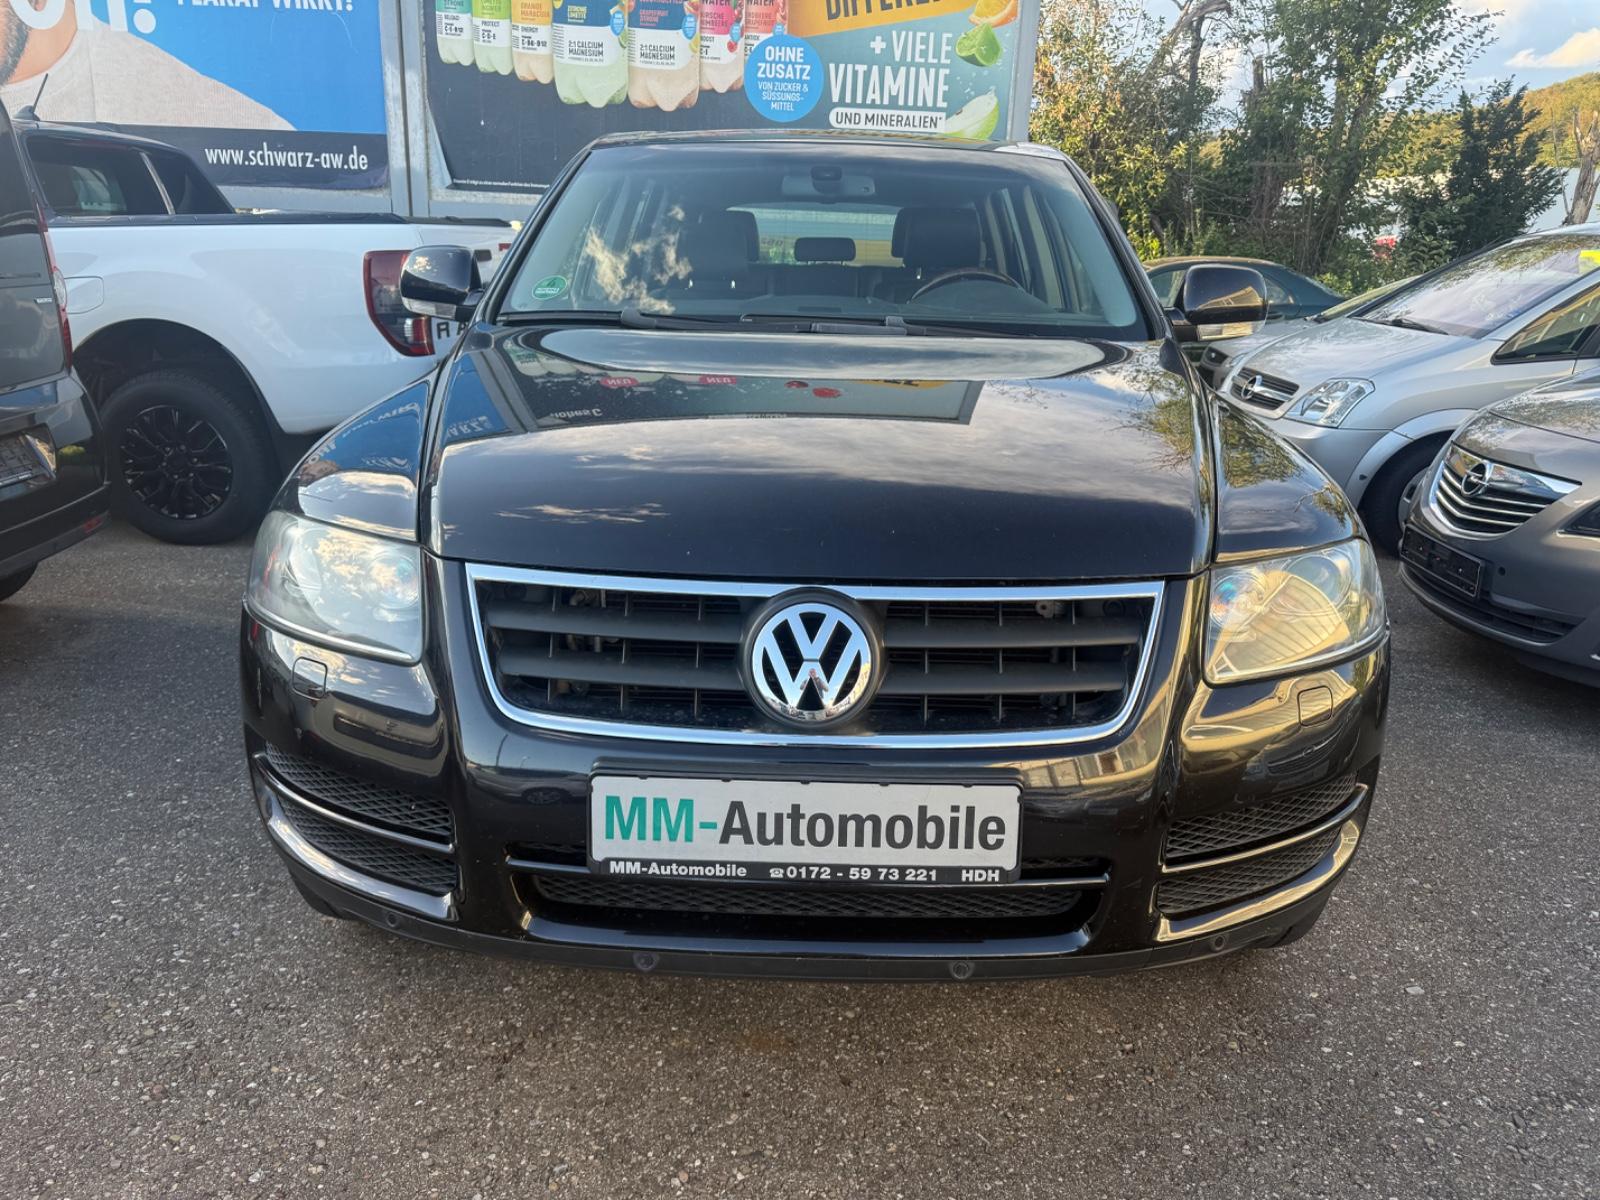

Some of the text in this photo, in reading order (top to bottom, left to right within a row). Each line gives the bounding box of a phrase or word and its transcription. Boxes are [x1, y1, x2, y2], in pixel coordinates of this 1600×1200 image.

[577, 40, 604, 49] CALCIUM
[648, 44, 675, 53] CALCIUM
[891, 30, 953, 65] VIELE
[568, 48, 604, 57] MAGNESIUM
[640, 52, 675, 60] MAGNESIUM
[764, 45, 805, 63] OHNE
[756, 62, 811, 81] ZUSATZ
[758, 80, 809, 93] VON ZUCKER &
[828, 63, 951, 108] VITAMINE
[762, 89, 805, 102] SÜSSUNGS-
[770, 101, 795, 112] MITTEL
[835, 111, 861, 125] UND
[204, 141, 369, 170] www.schwarz-aw.de
[605, 795, 1006, 851] MM-Automobile
[609, 860, 748, 877] MM-Automobile
[786, 866, 831, 879] 0172
[849, 867, 871, 880] 59
[877, 868, 899, 881] 73
[905, 868, 937, 881] 221
[961, 869, 1000, 882] HDH
